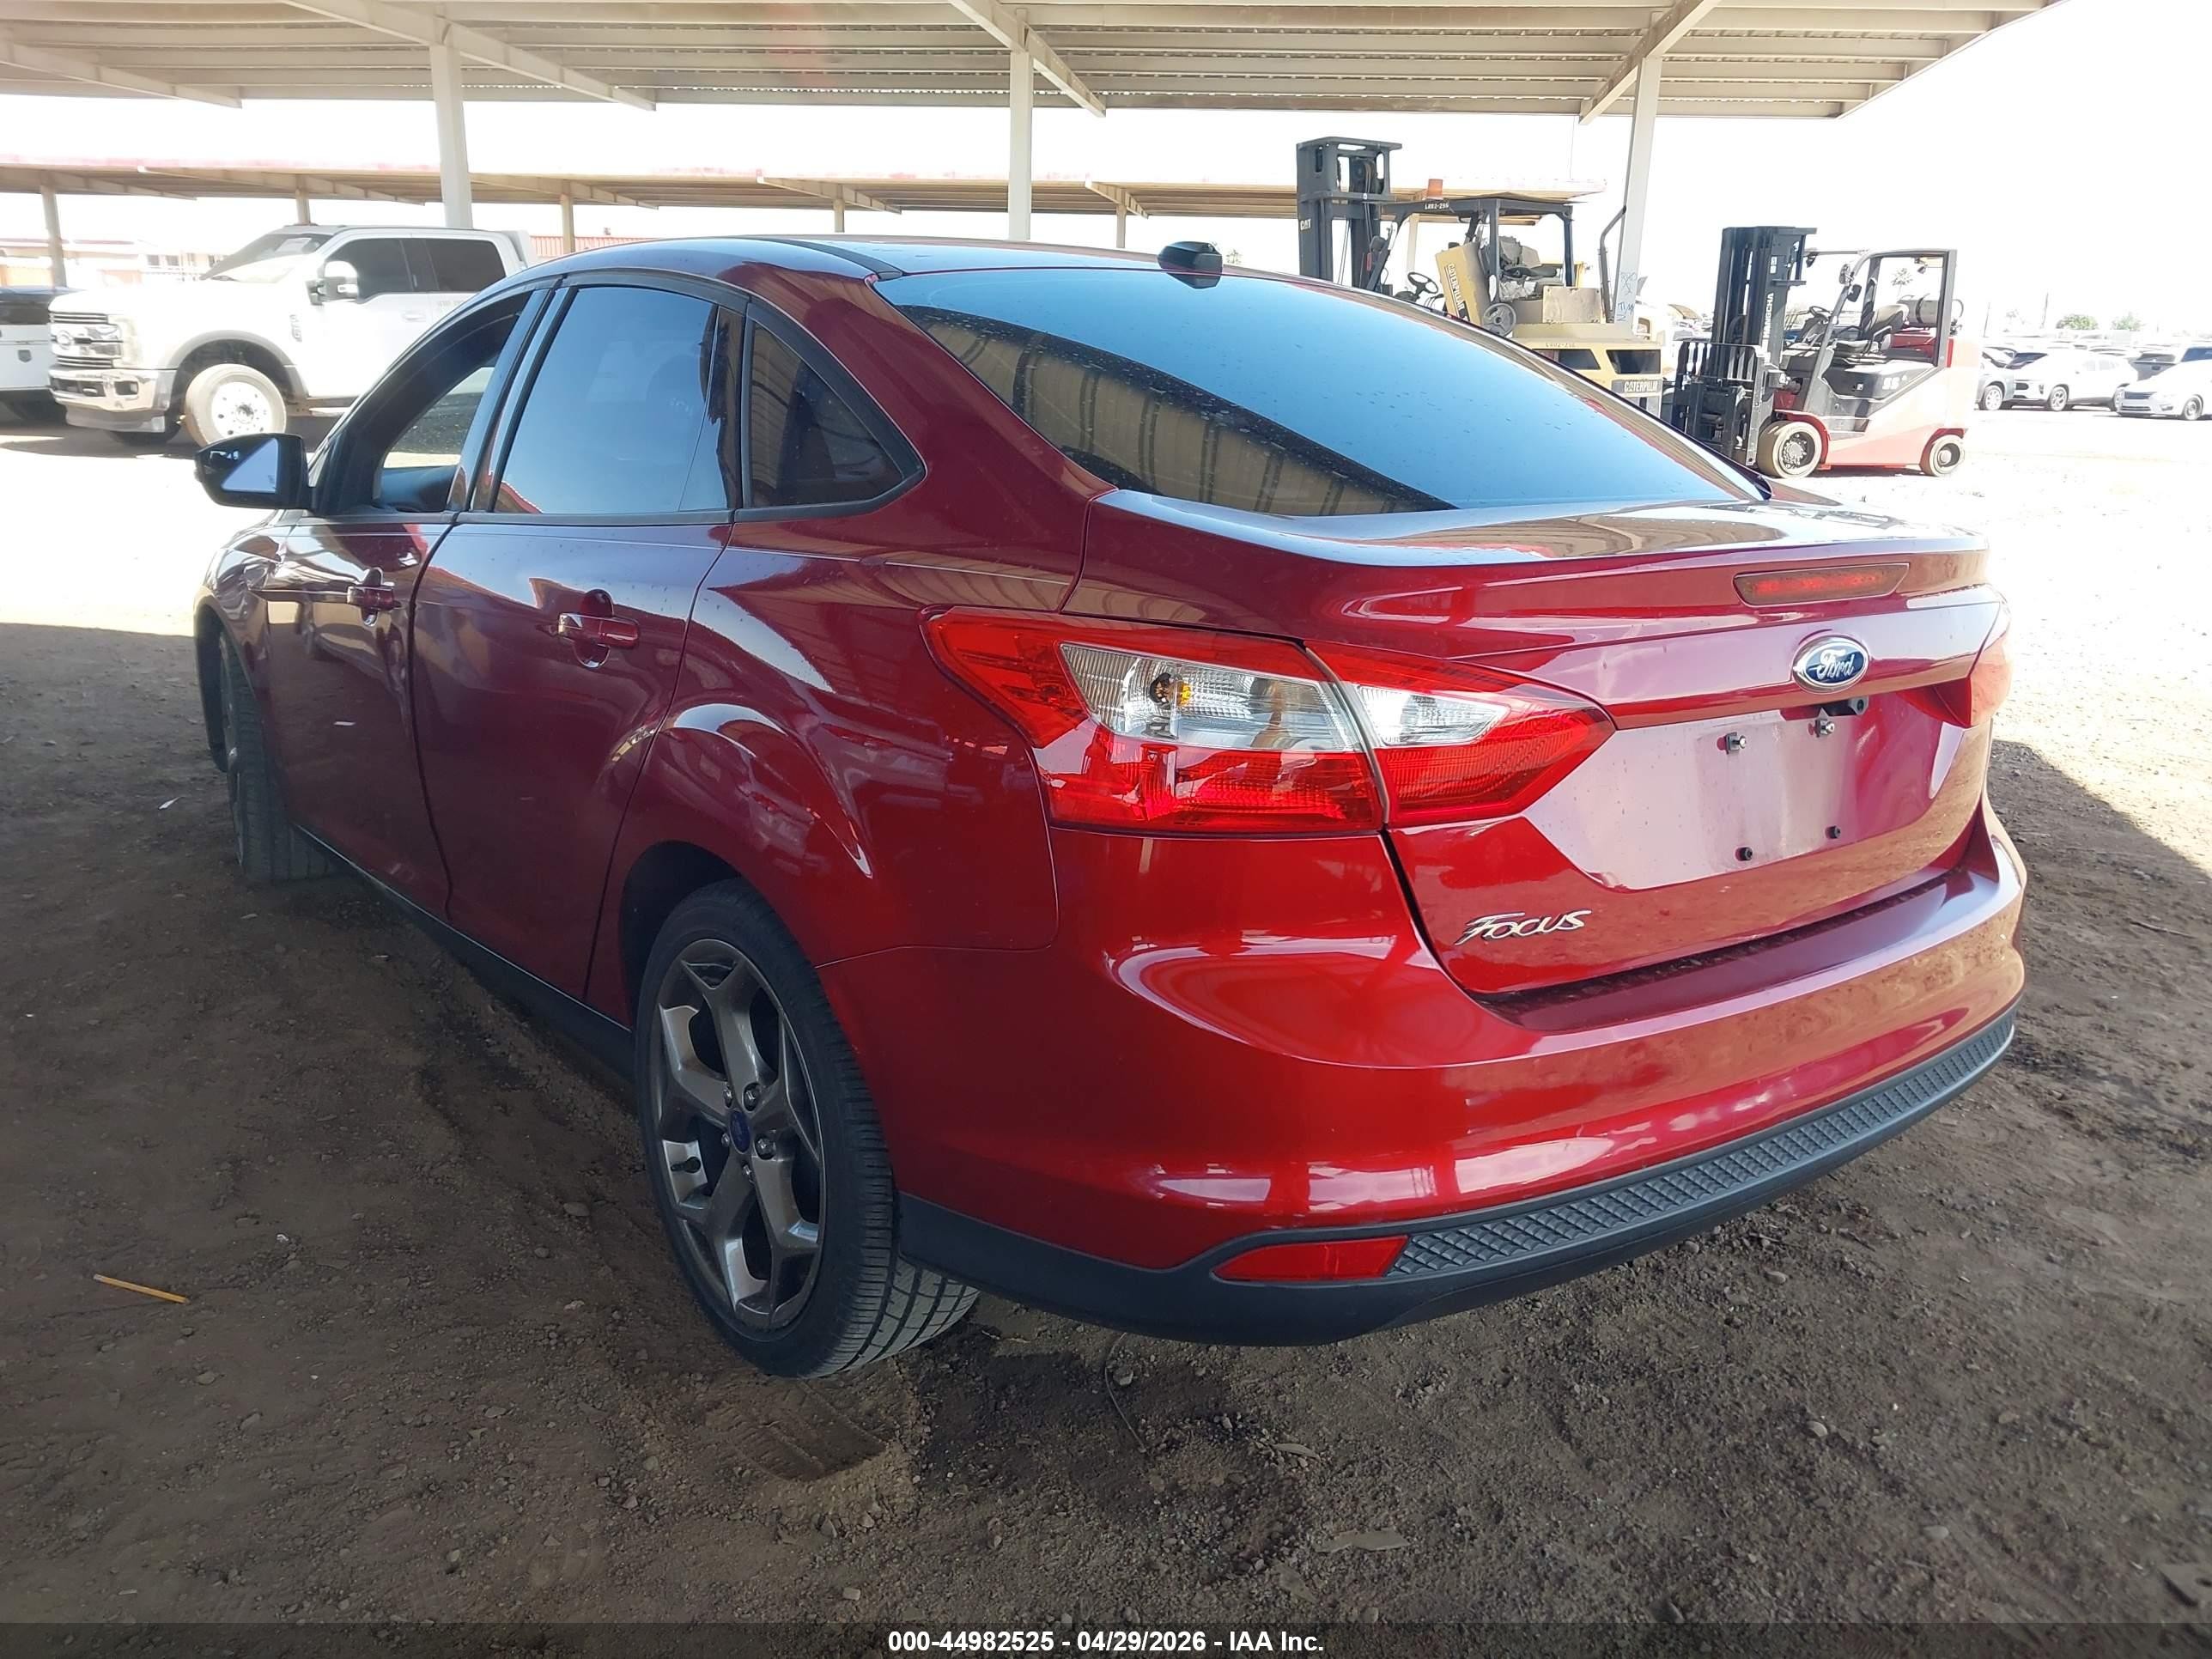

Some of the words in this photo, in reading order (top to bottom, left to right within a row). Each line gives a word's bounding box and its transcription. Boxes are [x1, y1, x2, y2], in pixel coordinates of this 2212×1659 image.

[1300, 218, 1311, 230] CAT
[1763, 292, 1774, 339] HANGCHA
[1807, 649, 1855, 679] Ford
